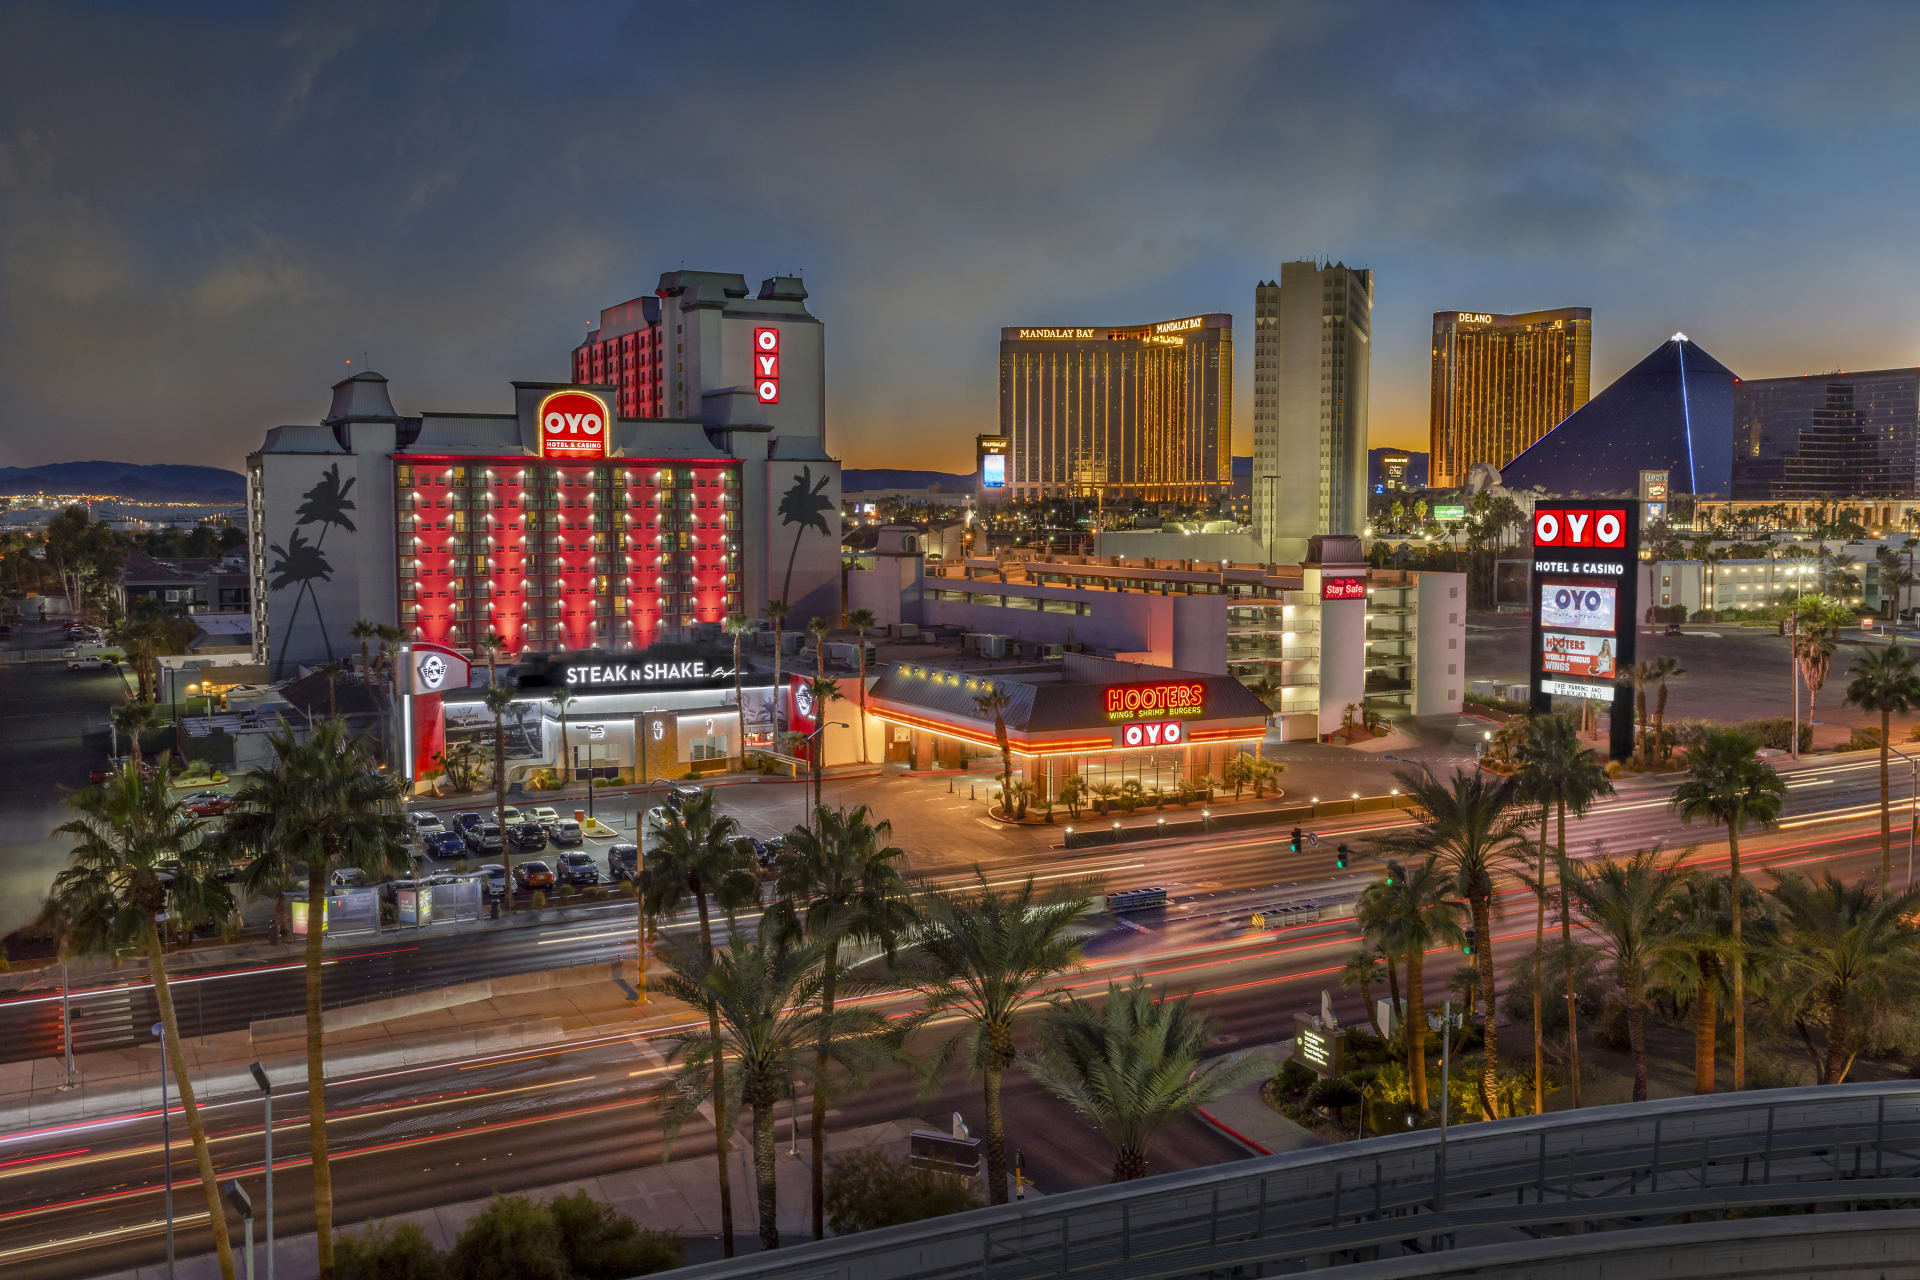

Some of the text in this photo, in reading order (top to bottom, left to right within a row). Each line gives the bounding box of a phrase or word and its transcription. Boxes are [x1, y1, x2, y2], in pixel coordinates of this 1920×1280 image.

[1156, 317, 1202, 333] MANDALAY BAY
[1459, 312, 1492, 324] DELANO
[1020, 329, 1095, 338] MANDALAY BAY
[759, 331, 776, 401] OYO
[544, 412, 602, 435] OYO
[1537, 514, 1620, 543] OYO
[1535, 561, 1624, 575] HOTEL & CASINO
[1326, 585, 1344, 596] Stay
[1345, 584, 1363, 593] Safe
[1555, 589, 1602, 611] OYO
[1546, 638, 1585, 650] HOOTERS
[1545, 653, 1591, 664] WORLD FAMOUS
[1545, 660, 1570, 672] WINGS
[566, 665, 628, 684] STEAK
[631, 669, 641, 681] N
[643, 662, 704, 680] SHAKE
[1108, 685, 1202, 711] HOOTERS
[1109, 706, 1201, 719] WINGS SHRIMP BURGERS
[1126, 724, 1180, 745] OYO
